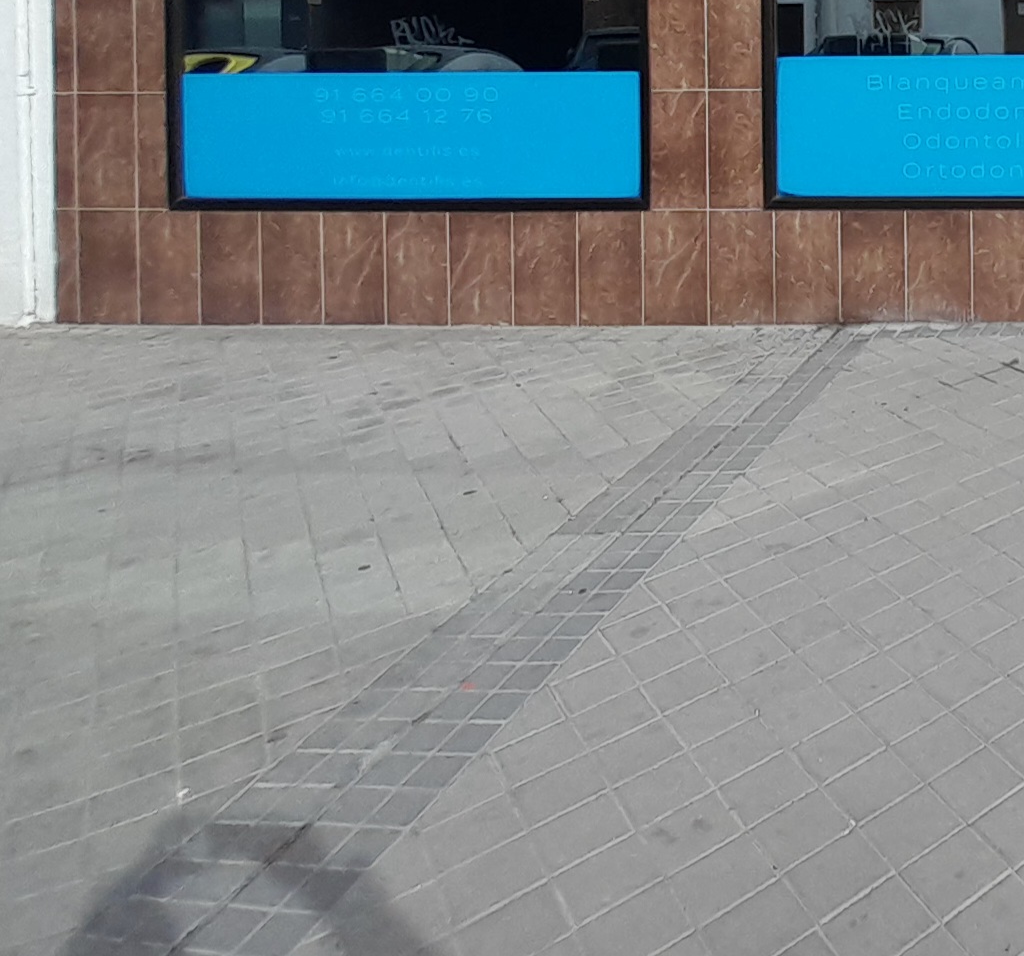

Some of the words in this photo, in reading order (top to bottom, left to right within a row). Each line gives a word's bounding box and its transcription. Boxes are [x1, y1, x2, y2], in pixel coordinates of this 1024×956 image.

[315, 87, 340, 103] 91
[352, 87, 403, 103] 664
[416, 87, 451, 103] 00
[463, 86, 499, 103] 90
[320, 108, 348, 124] 91
[359, 108, 410, 124] 664
[423, 108, 448, 124] 12
[461, 108, 493, 124] 76
